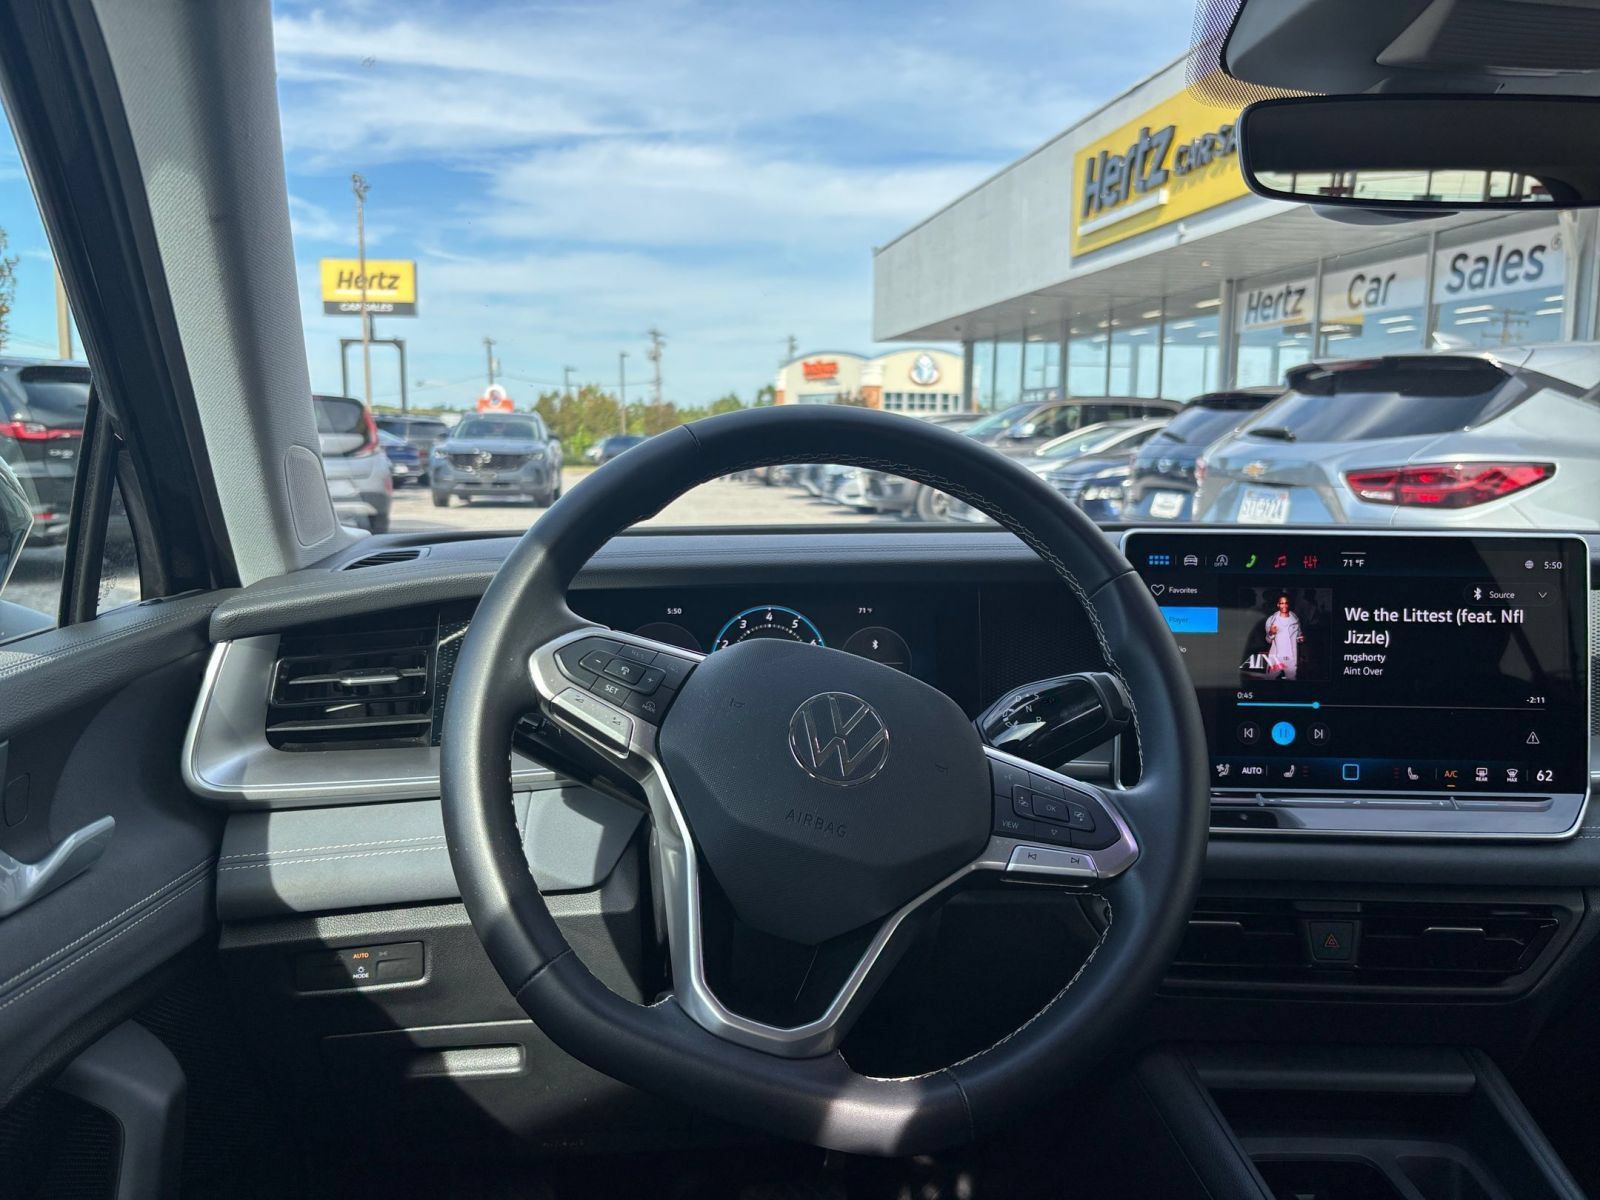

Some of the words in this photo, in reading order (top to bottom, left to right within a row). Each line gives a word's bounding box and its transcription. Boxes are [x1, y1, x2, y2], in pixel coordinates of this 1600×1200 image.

[1083, 125, 1175, 217] Hertz
[1174, 133, 1215, 175] CAR
[337, 271, 400, 290] Hertz
[1244, 286, 1307, 325] Hertz
[1346, 271, 1397, 310] Car
[1444, 243, 1548, 296] Sales
[1343, 559, 1353, 567] 71
[1544, 560, 1563, 570] 5:50
[1169, 586, 1198, 595] Favorites
[1489, 591, 1515, 599] Source
[667, 607, 682, 615] 5:50
[765, 612, 774, 622] 4
[1344, 607, 1369, 622] We
[1373, 607, 1399, 622] the
[1403, 608, 1453, 623] Littest
[1456, 609, 1497, 626] (feat.
[739, 619, 748, 629] 3
[791, 619, 800, 629] 5
[1344, 630, 1390, 648] Jizzle)
[1344, 653, 1386, 663] mgshorty
[1343, 667, 1361, 675] Aint
[1363, 667, 1383, 676] Over
[604, 683, 618, 695] SET
[1237, 691, 1253, 699] 0:45
[1526, 696, 1545, 704] -2:11
[1241, 767, 1262, 775] AUTO
[1444, 770, 1458, 778] A/C
[1536, 770, 1553, 782] 62
[785, 808, 847, 838] AIRBAG
[1002, 820, 1019, 829] VIEW
